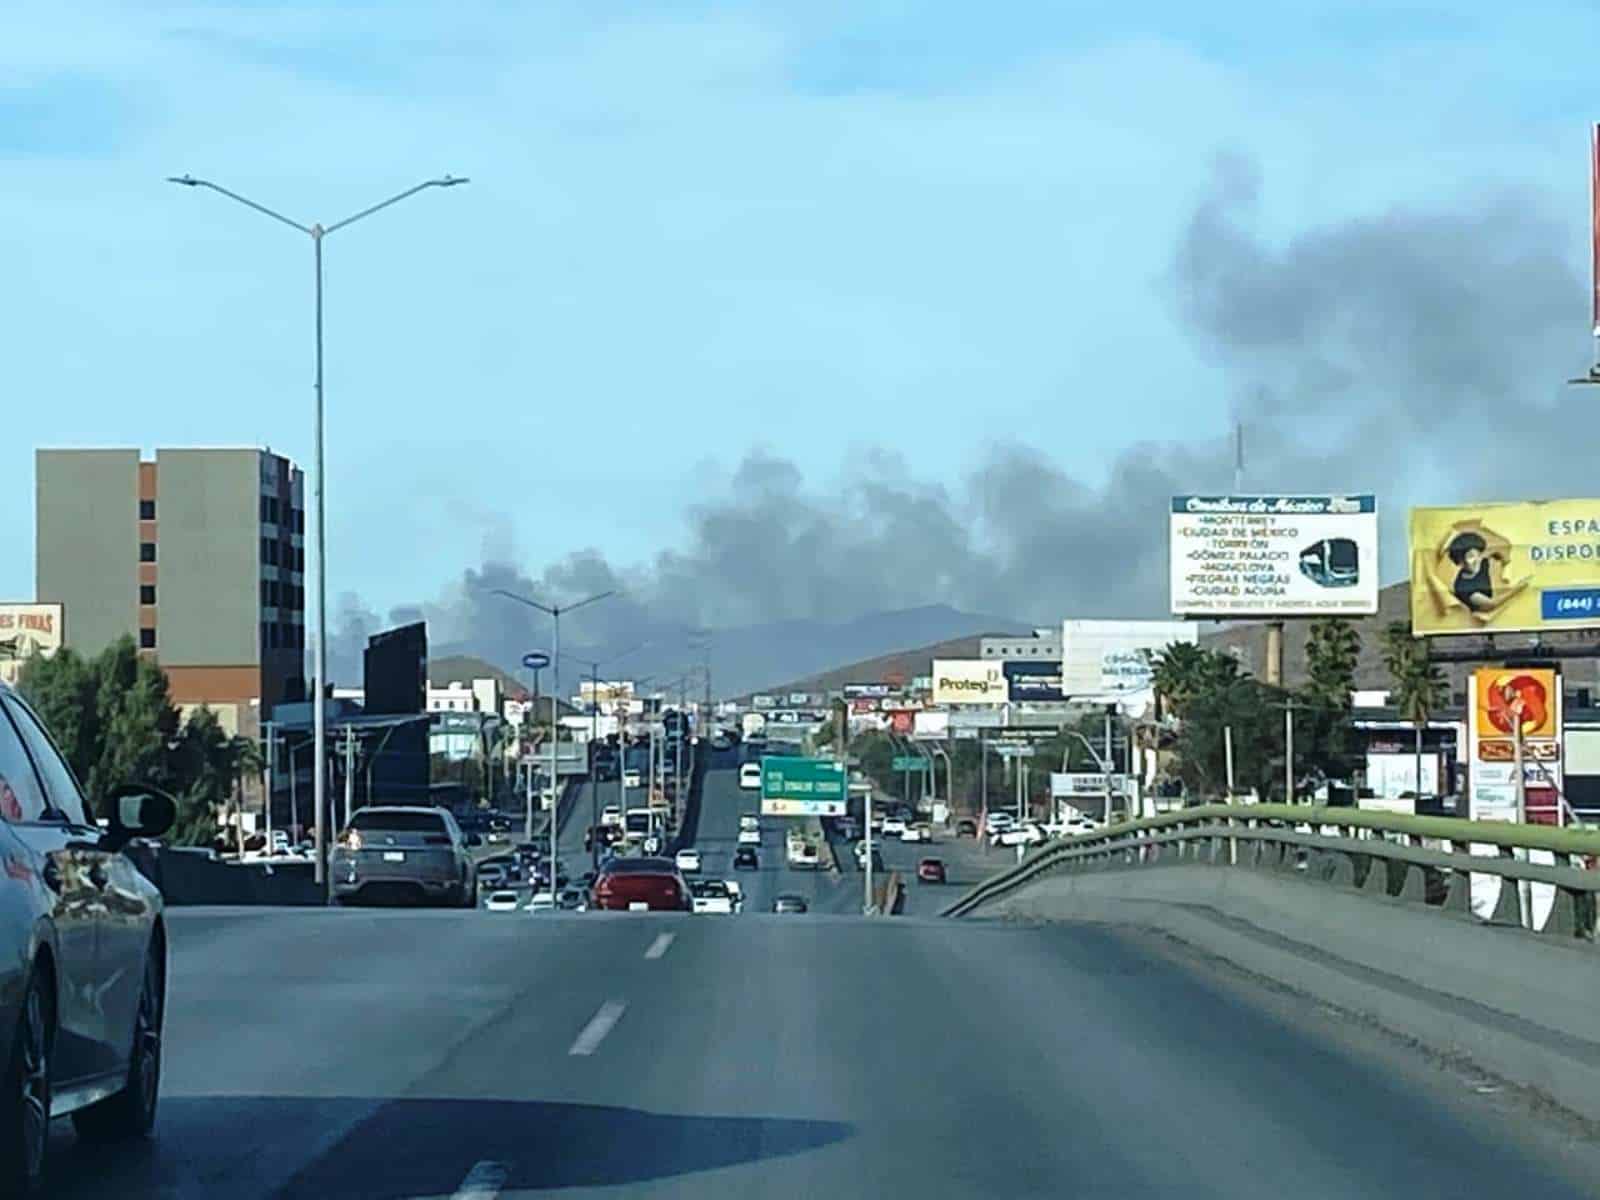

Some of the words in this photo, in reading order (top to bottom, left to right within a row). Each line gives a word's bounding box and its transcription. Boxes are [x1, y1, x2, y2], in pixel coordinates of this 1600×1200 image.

[1249, 498, 1267, 512] de
[1204, 516, 1276, 525] MONTERREY
[1548, 519, 1600, 535] ESPA
[1183, 528, 1228, 537] CIUDAD
[1232, 528, 1246, 537] DE
[1239, 551, 1289, 560] PALACIO
[1205, 563, 1274, 571] MONCLOVA
[1243, 574, 1290, 584] NEGRAS
[1194, 586, 1240, 595] CIUDAD
